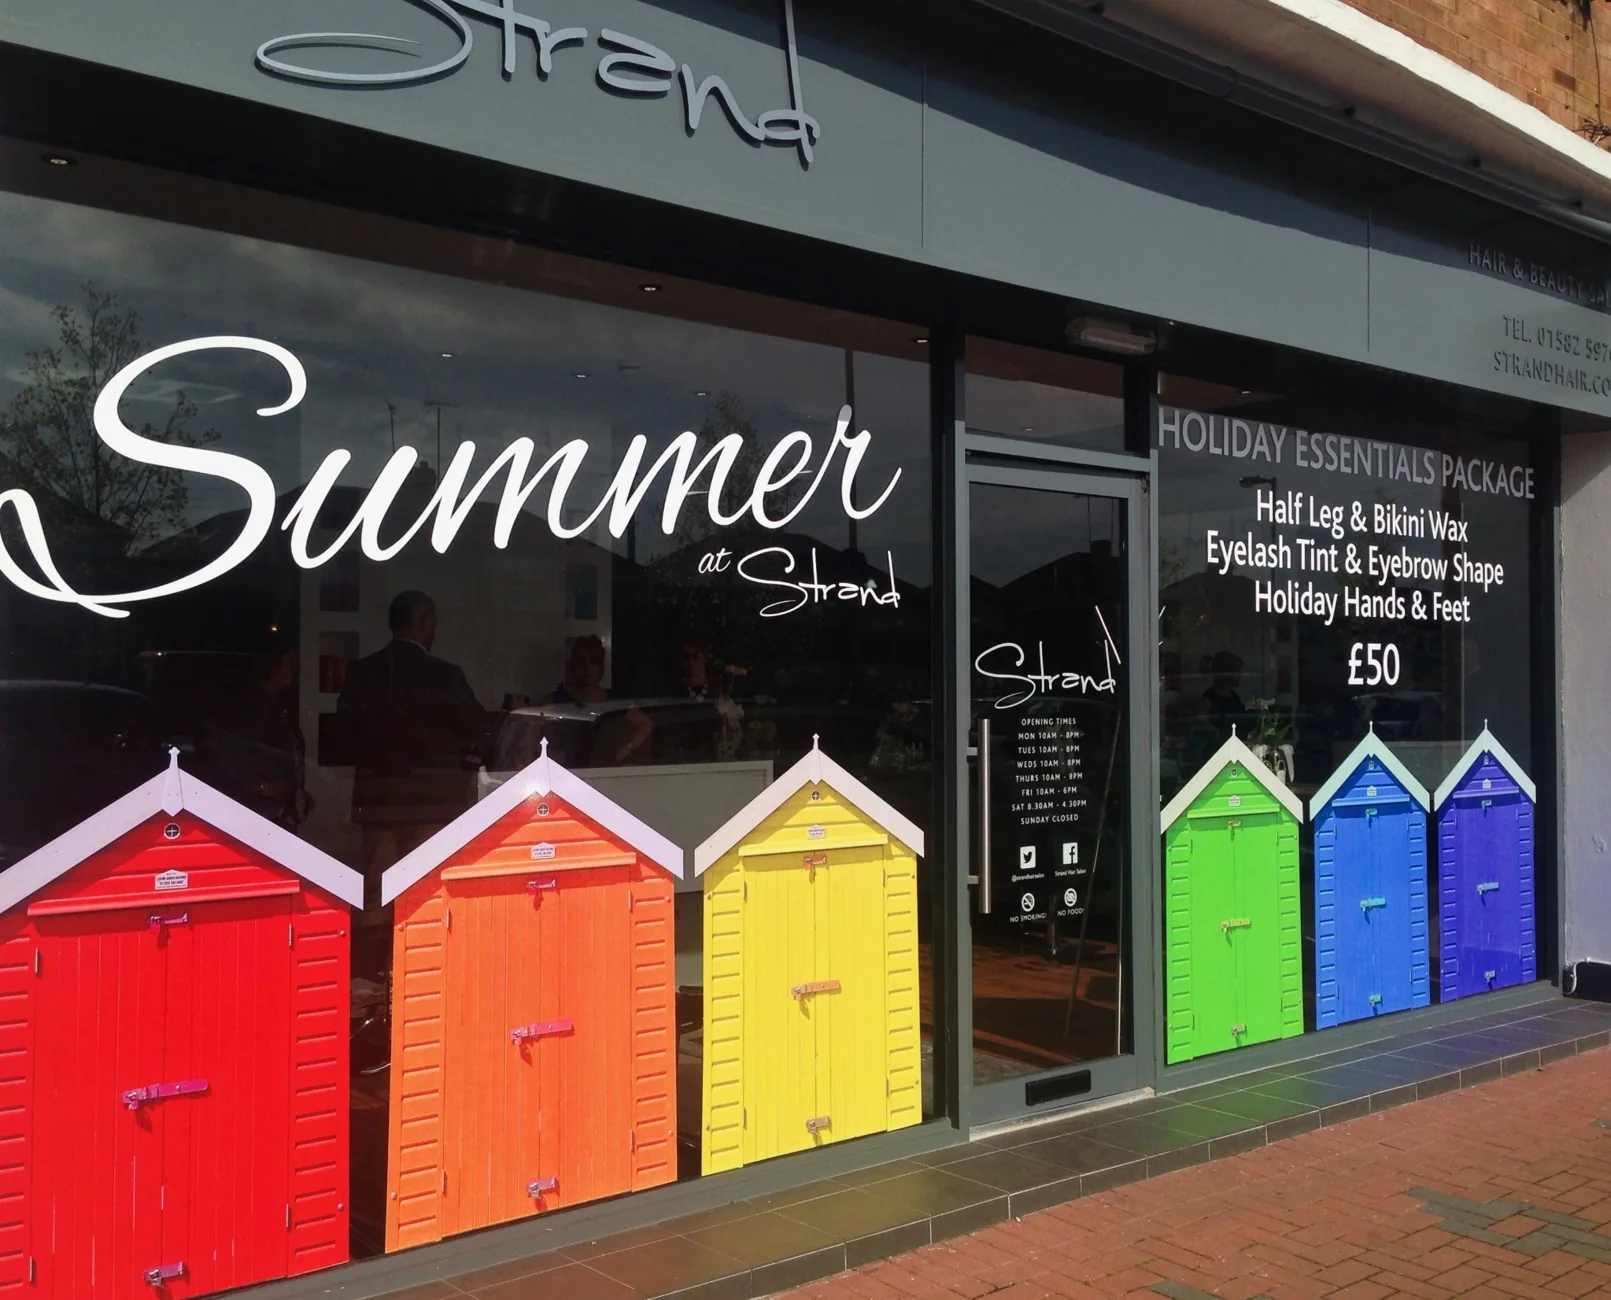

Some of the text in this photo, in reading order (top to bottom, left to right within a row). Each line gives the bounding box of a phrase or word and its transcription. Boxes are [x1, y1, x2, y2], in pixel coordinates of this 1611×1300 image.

[1469, 242, 1507, 275] HAIR
[1512, 258, 1524, 280] &
[1529, 262, 1584, 299] BEAUTY
[1502, 314, 1611, 363] TEL. 01582 597
[1493, 351, 1611, 397] STRANDHAIR.CO
[1158, 406, 1535, 499] HOLIDAY ESSENTIALS PACKAGE
[0, 335, 902, 618] Summer
[1257, 489, 1468, 543] Half Leg & Bikini Wax
[698, 546, 901, 617] at Strand
[1206, 530, 1504, 592] Eyelash Tint & Eyebrow Shape
[1255, 580, 1471, 626] Holiday Hands & Feet
[975, 640, 1117, 709] Strand
[1348, 642, 1400, 686] £50
[1018, 732, 1035, 740] MON
[1038, 731, 1057, 739] 10AM
[1065, 731, 1080, 739] 8PM
[1021, 717, 1077, 726] OPENING TIMES
[1016, 760, 1037, 768] WEDS
[1040, 759, 1059, 767] 10AM
[1067, 758, 1081, 766] 8PM
[1018, 746, 1036, 754] TUES
[1039, 745, 1058, 753] 10AM
[1065, 745, 1080, 753] 8PM
[1015, 774, 1039, 783] THURS
[1042, 773, 1061, 781] 10AM
[1068, 772, 1083, 780] 8PM
[1021, 788, 1033, 796] FRI
[1036, 787, 1055, 795] 10AM
[1062, 786, 1077, 794] 6PM
[1011, 803, 1025, 811] SAT
[1027, 801, 1054, 810] 8.30AM
[1020, 813, 1079, 825] SUNDAY CLOSED
[1009, 915, 1019, 923] NO
